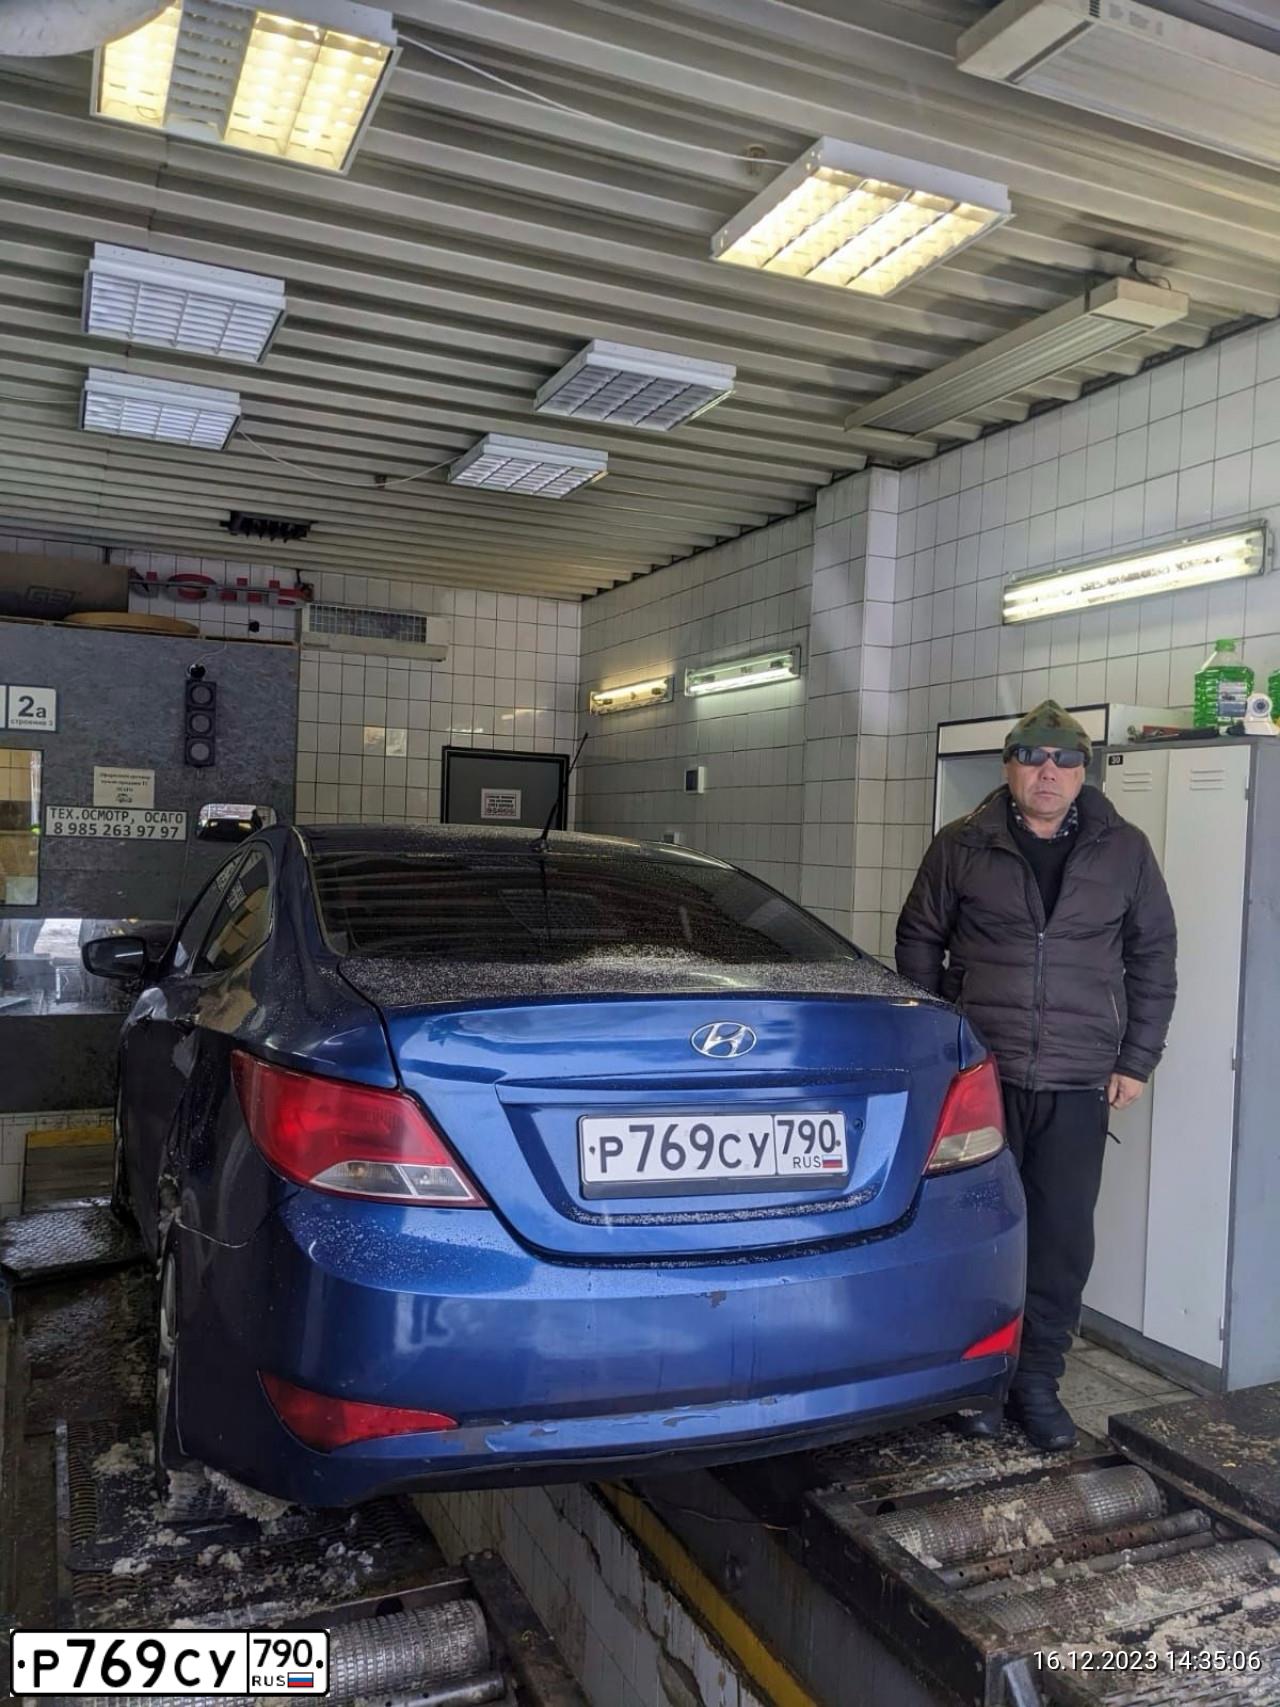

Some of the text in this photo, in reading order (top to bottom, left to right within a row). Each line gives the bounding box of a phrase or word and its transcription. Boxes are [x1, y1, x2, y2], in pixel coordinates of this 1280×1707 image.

[18, 695, 47, 718] 2а
[144, 811, 184, 824] ОСАГО
[54, 821, 179, 838] 8 985 263 97 97
[599, 1118, 837, 1174] Р769СУ 790
[793, 1156, 822, 1169] RUS
